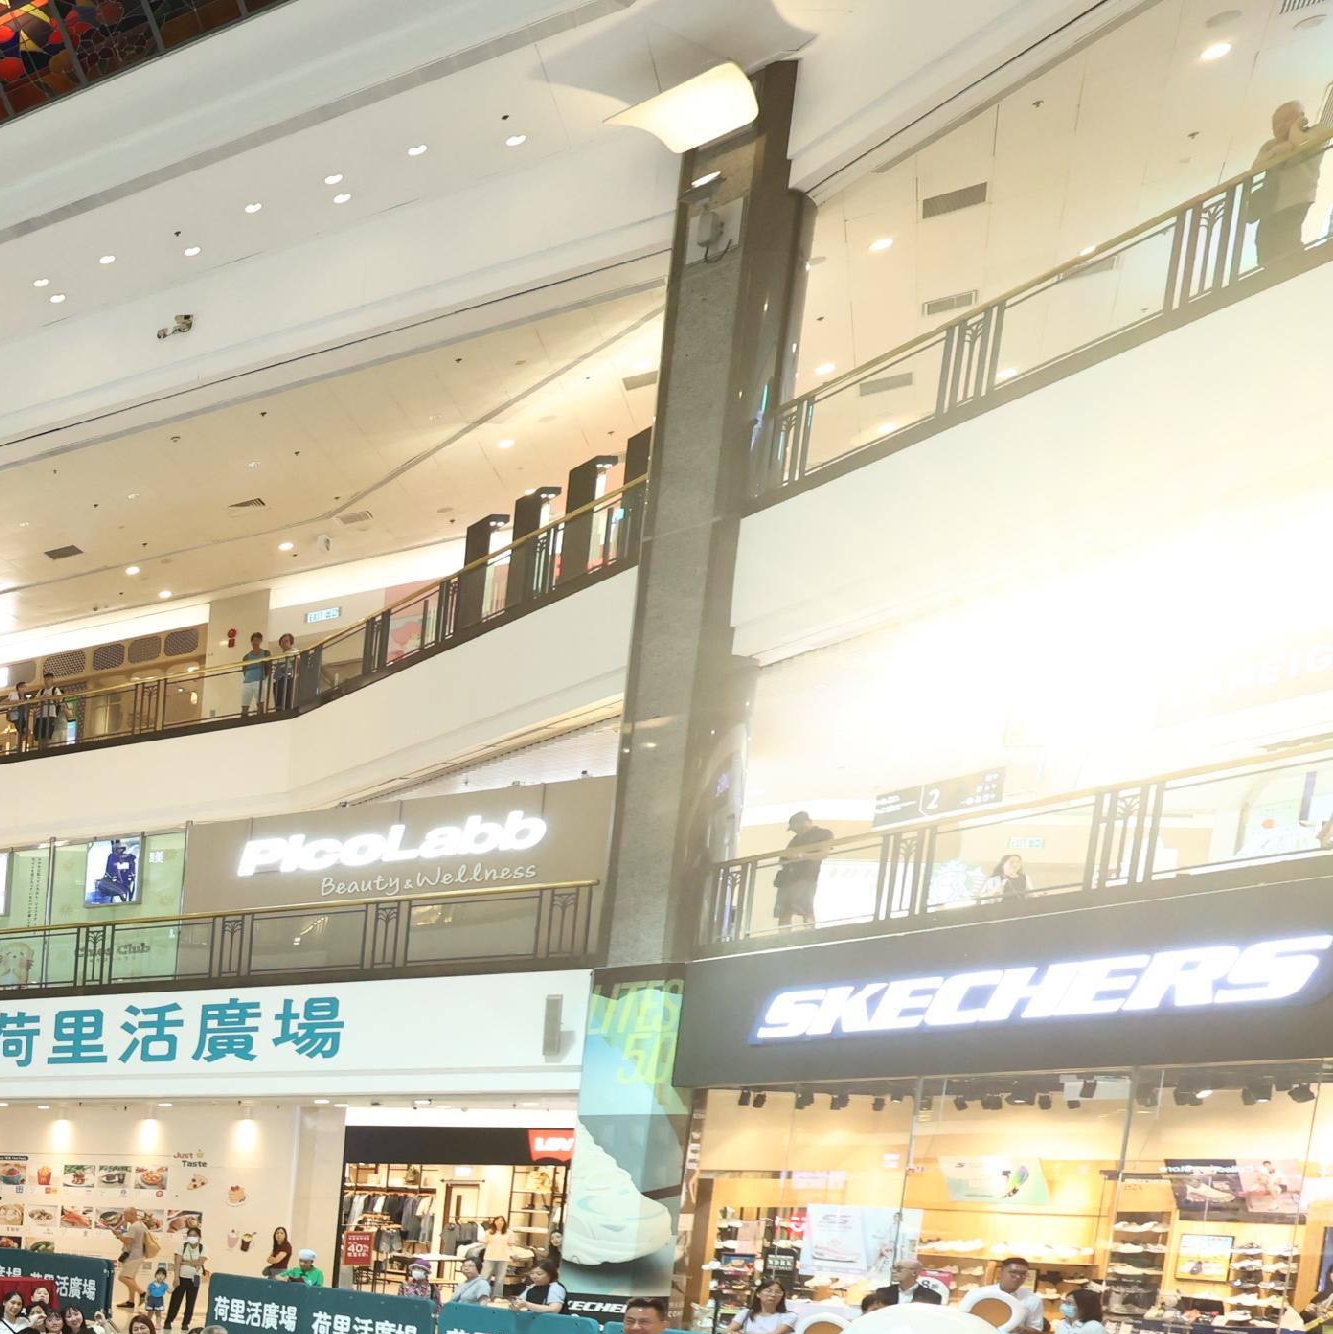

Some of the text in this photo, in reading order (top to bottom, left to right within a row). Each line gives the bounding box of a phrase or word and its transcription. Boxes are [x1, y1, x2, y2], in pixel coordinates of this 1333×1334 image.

[927, 787, 941, 809] 2
[237, 810, 548, 877] PicoLabb
[321, 863, 537, 896] Beauty & Wellness
[756, 933, 1333, 1042] SKECHERS
[173, 1151, 194, 1159] Just
[181, 1160, 208, 1168] Taste
[213, 1296, 298, 1333] 荷里活廣場
